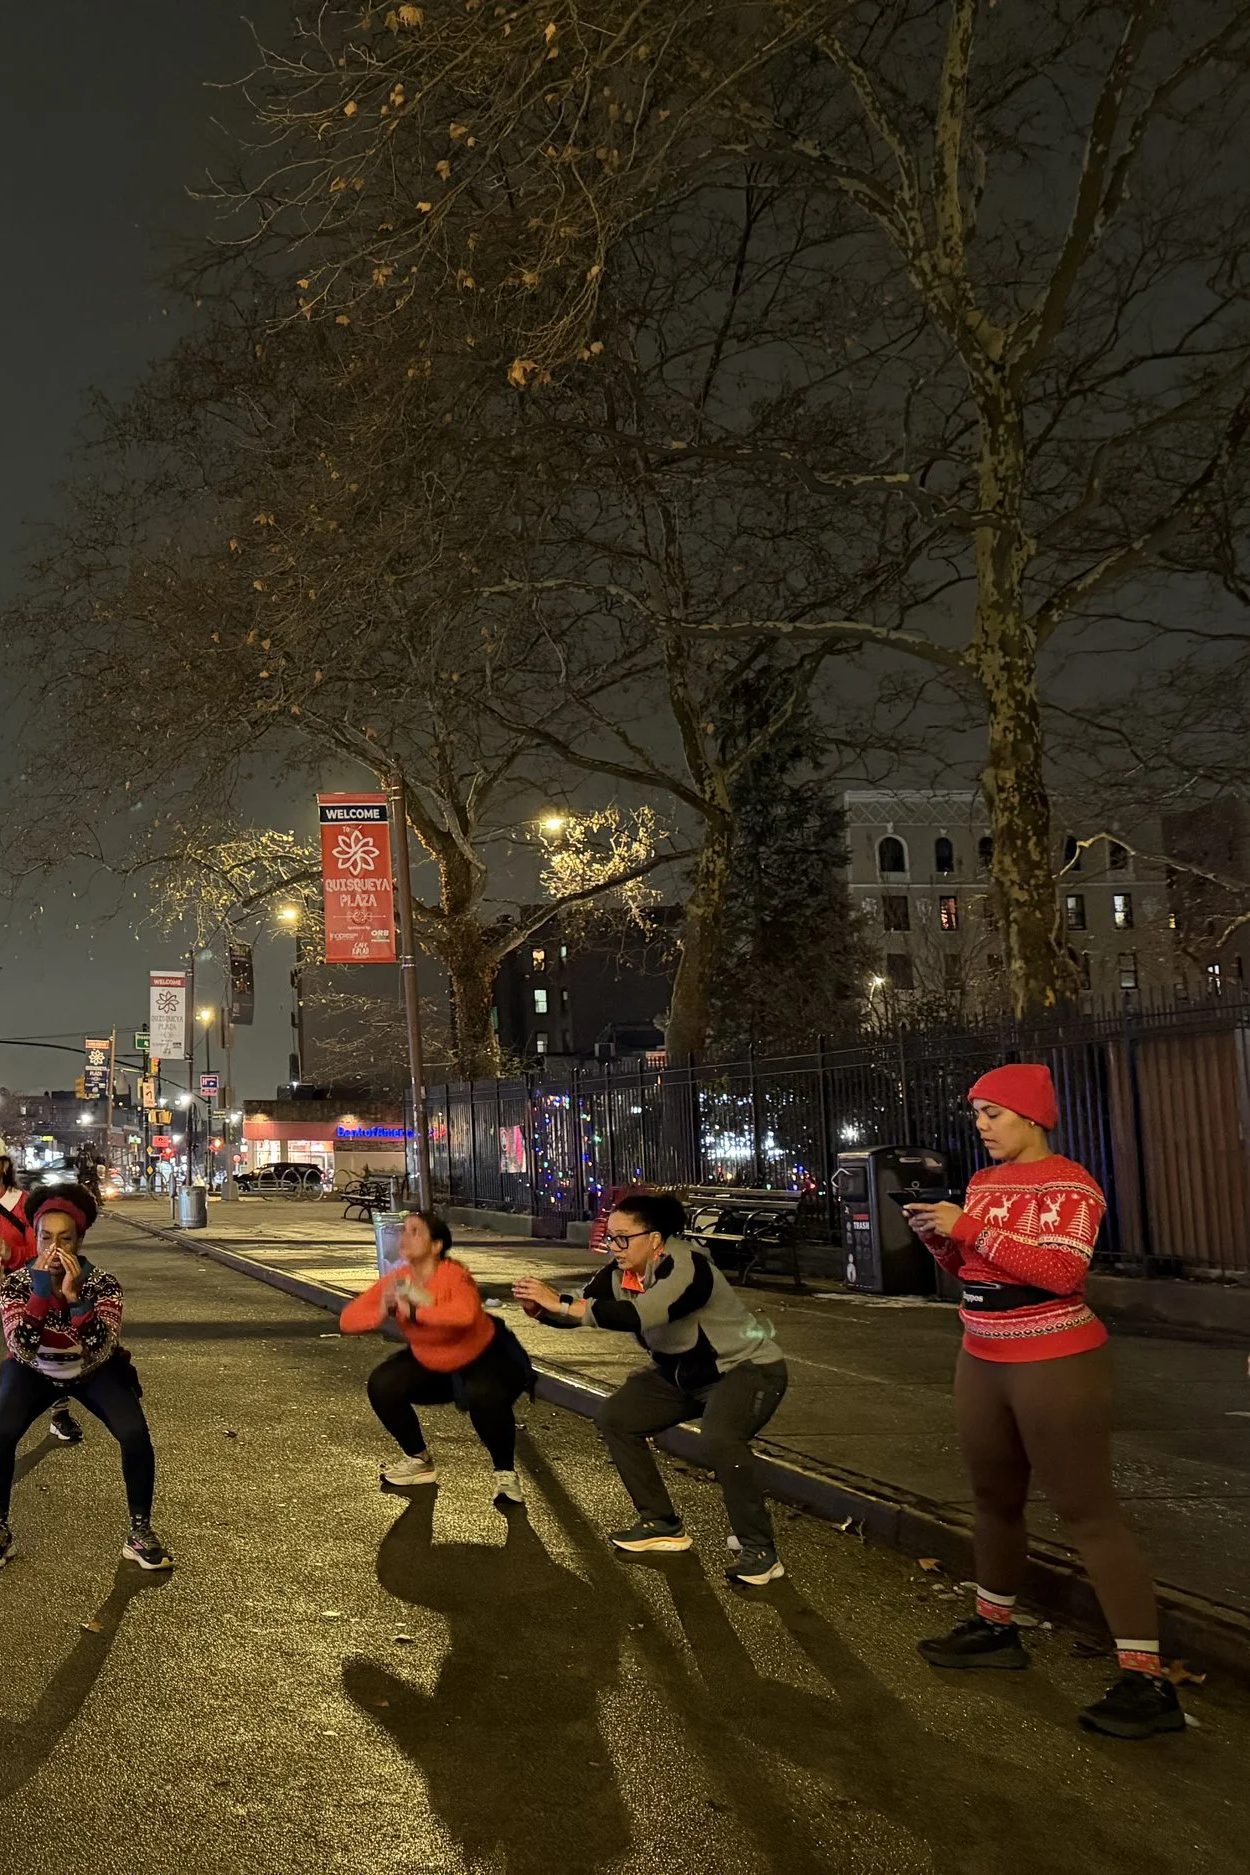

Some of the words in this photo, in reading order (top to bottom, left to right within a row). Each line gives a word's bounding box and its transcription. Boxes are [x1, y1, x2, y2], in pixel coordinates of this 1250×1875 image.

[325, 808, 381, 820] WELCOME
[325, 878, 391, 893] QUISQUEYA
[339, 893, 378, 908] PLAZA
[371, 929, 390, 937] ORB
[153, 978, 182, 986] WELCOME
[337, 1126, 363, 1137] Bank
[364, 1126, 376, 1137] of
[853, 1221, 870, 1230] TRASH
